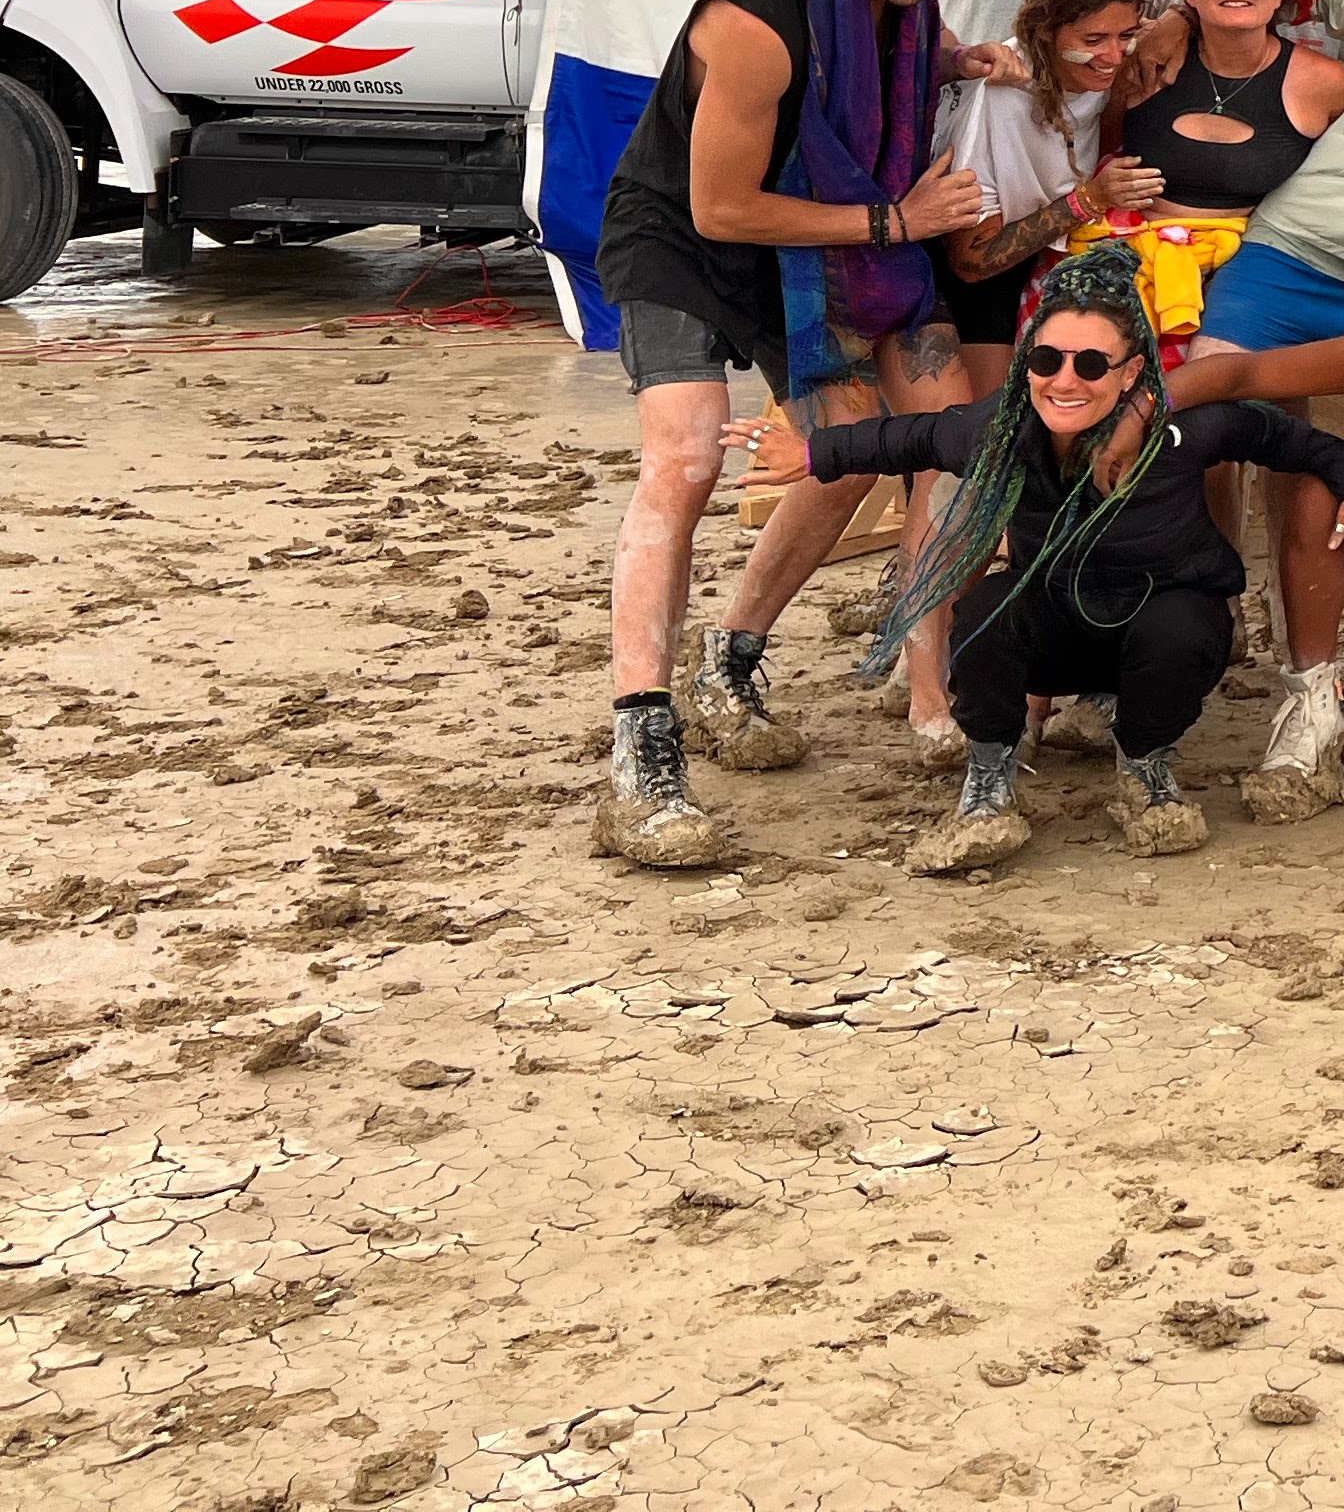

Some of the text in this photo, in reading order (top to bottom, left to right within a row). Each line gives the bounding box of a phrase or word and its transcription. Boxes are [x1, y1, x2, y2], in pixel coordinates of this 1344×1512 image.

[255, 76, 404, 95] UNDER 22,000 GROSS
